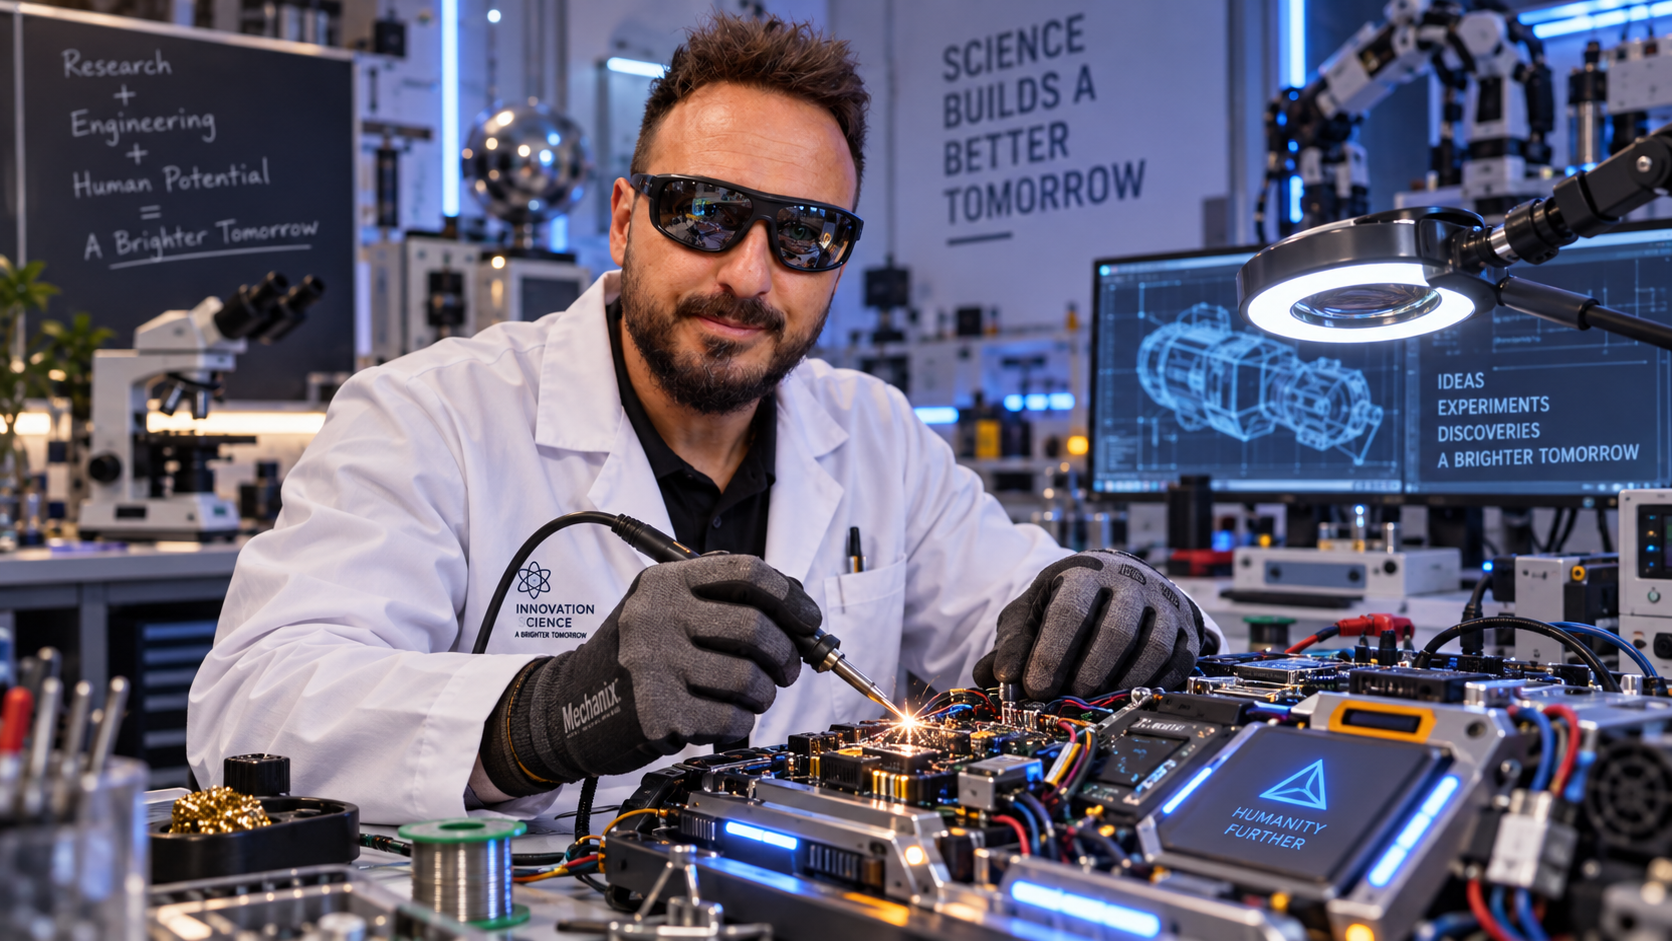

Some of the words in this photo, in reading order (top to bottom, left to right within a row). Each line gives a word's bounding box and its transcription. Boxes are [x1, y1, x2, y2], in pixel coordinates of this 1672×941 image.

[943, 13, 1085, 82] SCIENCE
[63, 49, 172, 78] Research
[944, 71, 1060, 130] BUILDS
[1073, 63, 1096, 104] A
[71, 108, 216, 147] Engineering
[944, 120, 1068, 177] BETTER
[73, 170, 152, 199] Human
[163, 156, 270, 192] Potential
[944, 159, 1146, 225] TOMORROW
[84, 233, 103, 261] A
[114, 225, 208, 263] Brighter
[215, 218, 319, 244] Tomorrow
[1438, 372, 1485, 390] IDEAS
[1438, 396, 1550, 416] EXPERIMENTS
[1438, 422, 1541, 442] DISCOVERIES
[1437, 452, 1449, 469] A
[1455, 449, 1533, 468] BRIGHTER
[1539, 443, 1640, 464] TOMORROW
[516, 603, 595, 615] INNOVATION
[1231, 806, 1327, 835] HUMANITY
[1223, 823, 1306, 850] FURTHER
